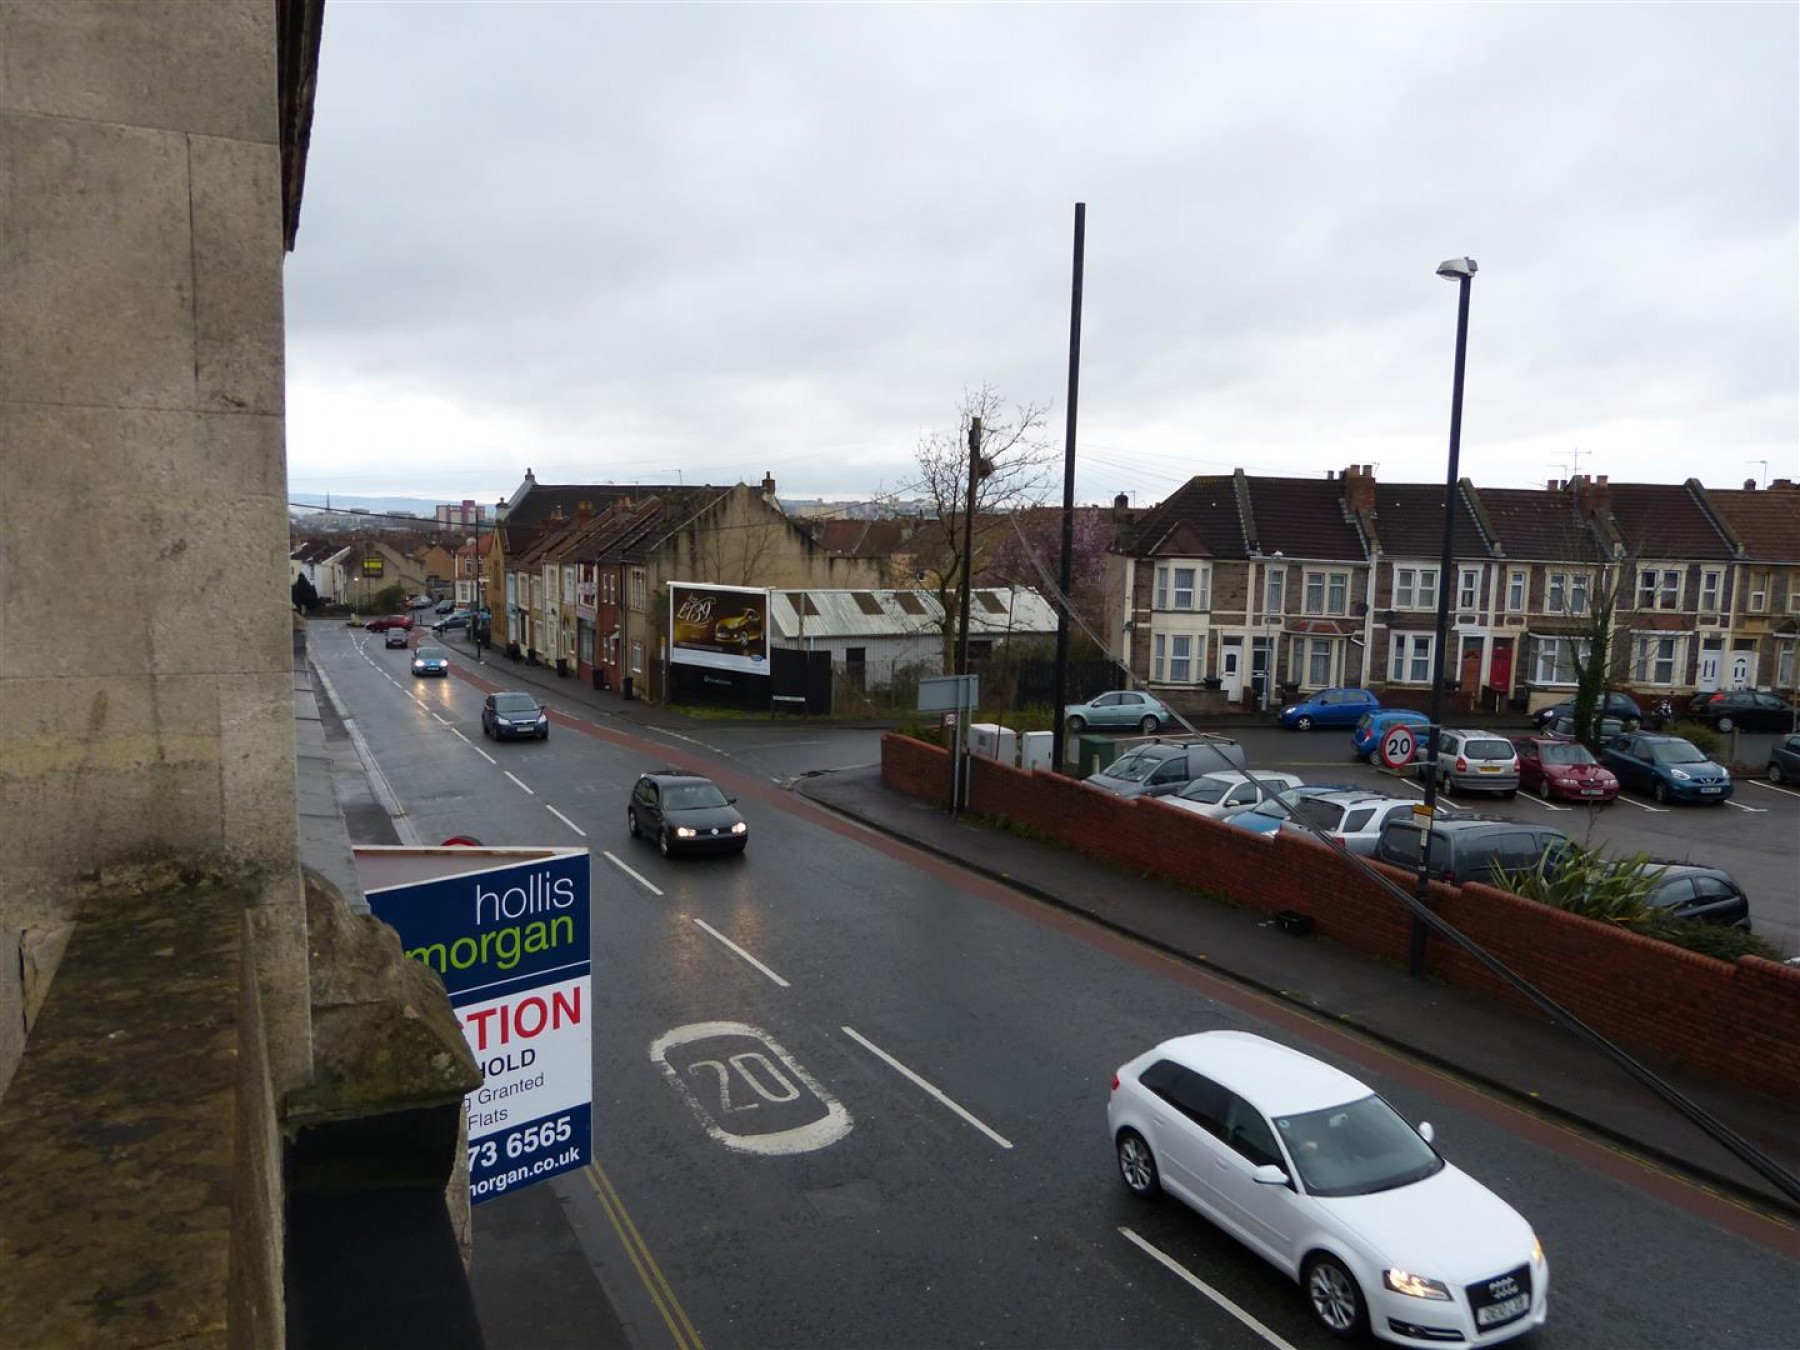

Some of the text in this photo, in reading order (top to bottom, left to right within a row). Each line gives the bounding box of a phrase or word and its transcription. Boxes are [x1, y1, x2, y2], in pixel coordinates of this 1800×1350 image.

[1389, 738, 1410, 756] 20
[476, 872, 575, 926] hollis
[460, 986, 581, 1051] TION
[478, 1072, 544, 1105] Granted
[688, 1052, 800, 1113] 20
[468, 1108, 508, 1131] Flats
[506, 1116, 571, 1158] 6565
